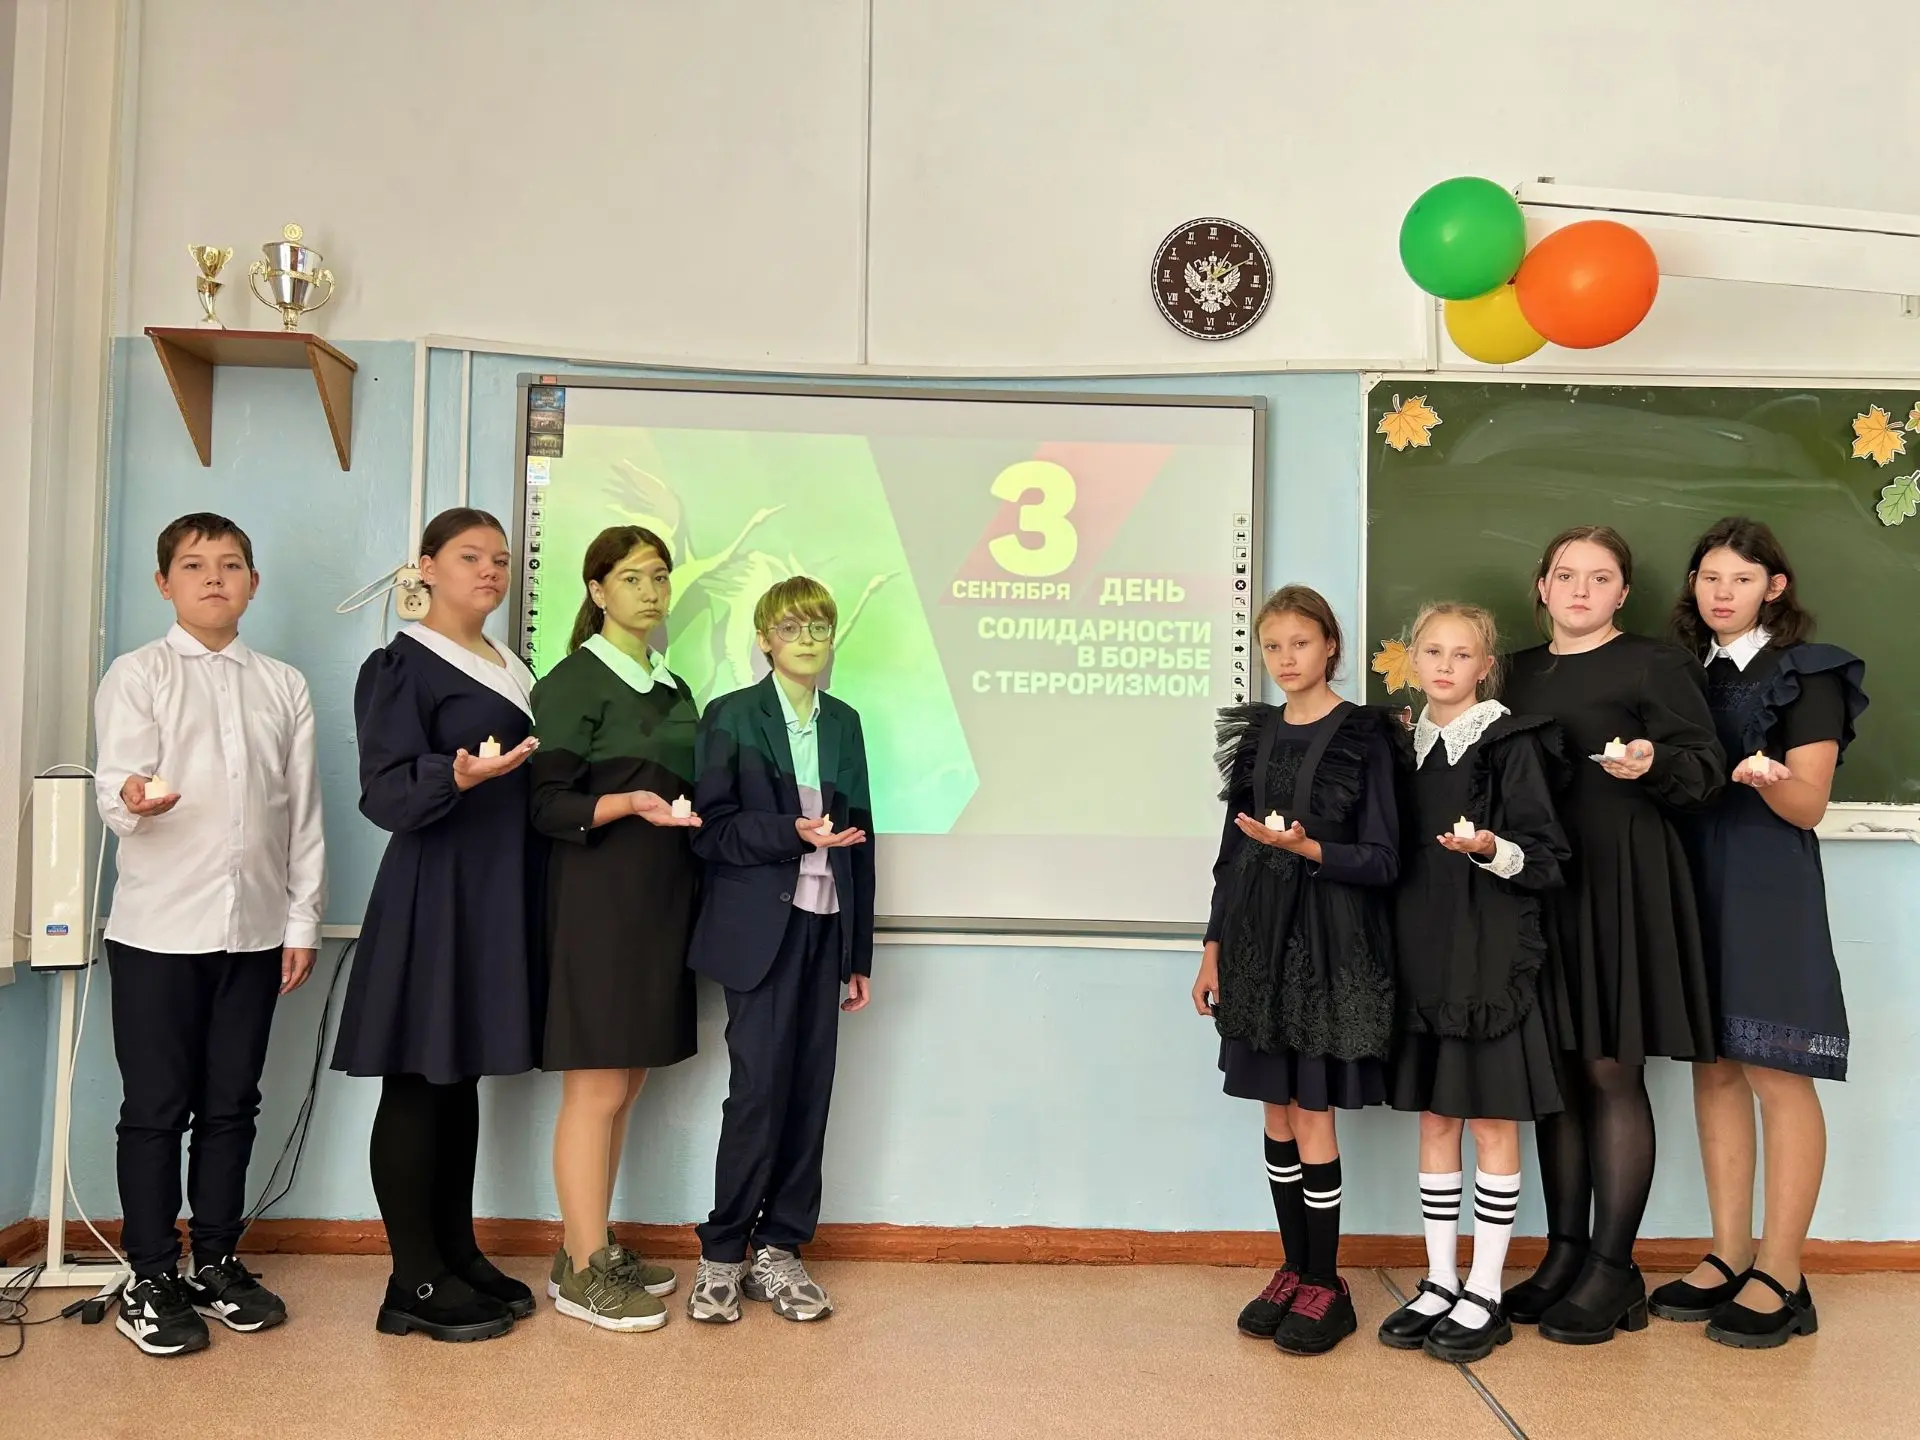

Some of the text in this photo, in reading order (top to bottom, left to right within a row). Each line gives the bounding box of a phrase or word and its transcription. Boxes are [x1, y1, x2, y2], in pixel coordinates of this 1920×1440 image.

[1206, 317, 1215, 327] VI
[1229, 312, 1236, 321] V
[988, 460, 1078, 577] 3
[952, 580, 1071, 600] СЕНТЯБРЯ
[1099, 578, 1186, 606] ДЕНЬ
[977, 616, 1212, 645] СОЛИДАРНОСТИ
[1077, 646, 1212, 670] В БОРЬБЕ
[972, 670, 1210, 698] С ТЕРРОРИЗМОМ
